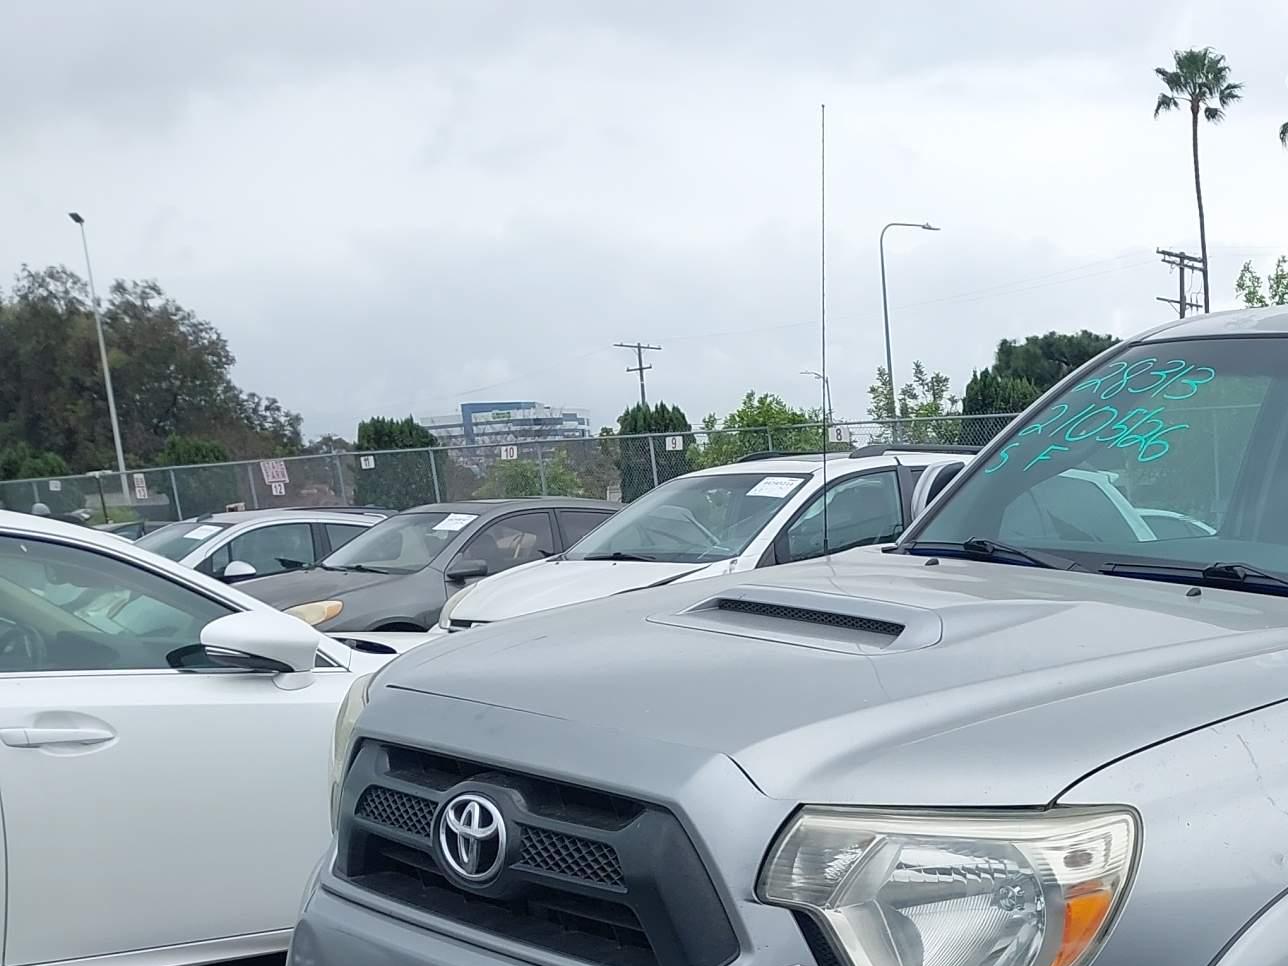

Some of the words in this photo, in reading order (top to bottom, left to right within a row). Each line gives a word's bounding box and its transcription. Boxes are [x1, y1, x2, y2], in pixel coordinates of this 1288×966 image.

[836, 428, 842, 441] 8
[671, 437, 677, 449] 9
[503, 446, 515, 458] 10
[273, 483, 283, 494] 12
